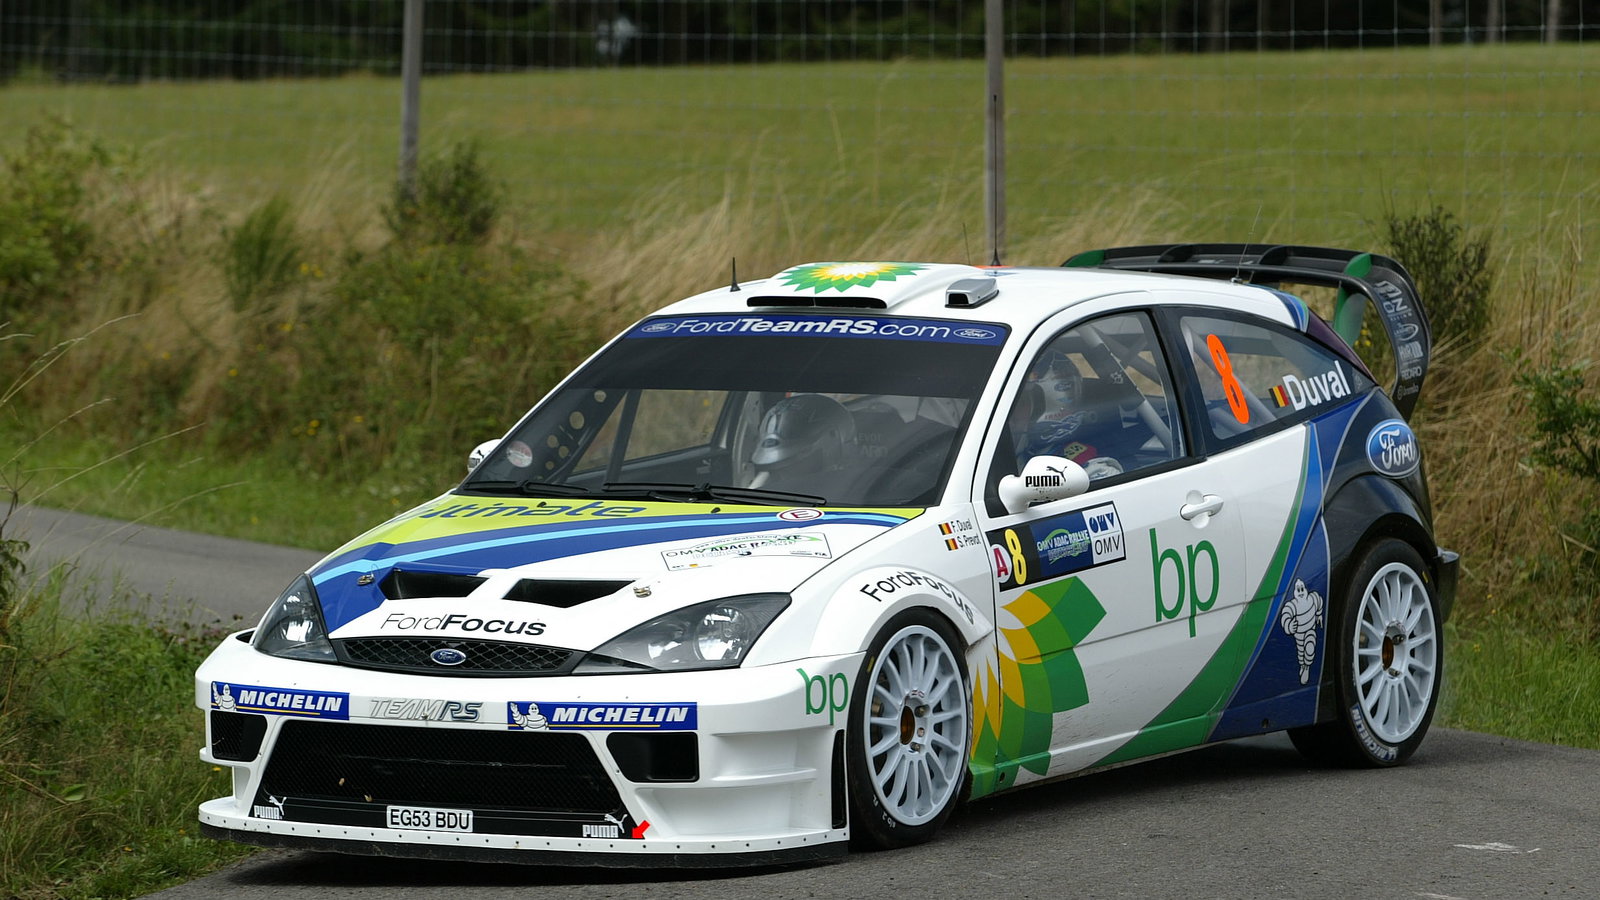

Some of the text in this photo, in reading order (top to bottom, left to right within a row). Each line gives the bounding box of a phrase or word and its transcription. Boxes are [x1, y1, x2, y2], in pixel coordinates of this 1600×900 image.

[672, 318, 950, 338] FordTeamRS.com
[1206, 333, 1250, 424] 8
[1282, 360, 1351, 411] Duval
[1378, 428, 1417, 470] Ford
[1025, 475, 1060, 487] PUMA
[790, 510, 813, 518] E
[665, 547, 706, 558] OMV
[710, 543, 748, 553] ADAC
[1036, 538, 1053, 552] OMV
[1053, 535, 1069, 548] ADAC
[1068, 529, 1090, 544] RALLYE
[1094, 535, 1120, 556] OMV
[993, 547, 1009, 578] A
[1004, 528, 1027, 585] 8
[1149, 527, 1220, 639] bp
[859, 571, 974, 625] FordFocus
[380, 613, 547, 636] FordFocus
[238, 690, 343, 712] MICHELIN
[796, 667, 849, 726] bp
[551, 707, 688, 723] MICHELIN
[1352, 708, 1388, 759] MICHELIN
[253, 805, 280, 819] PUMA
[390, 809, 470, 830] EG53 BDU
[582, 824, 619, 838] PUMA
